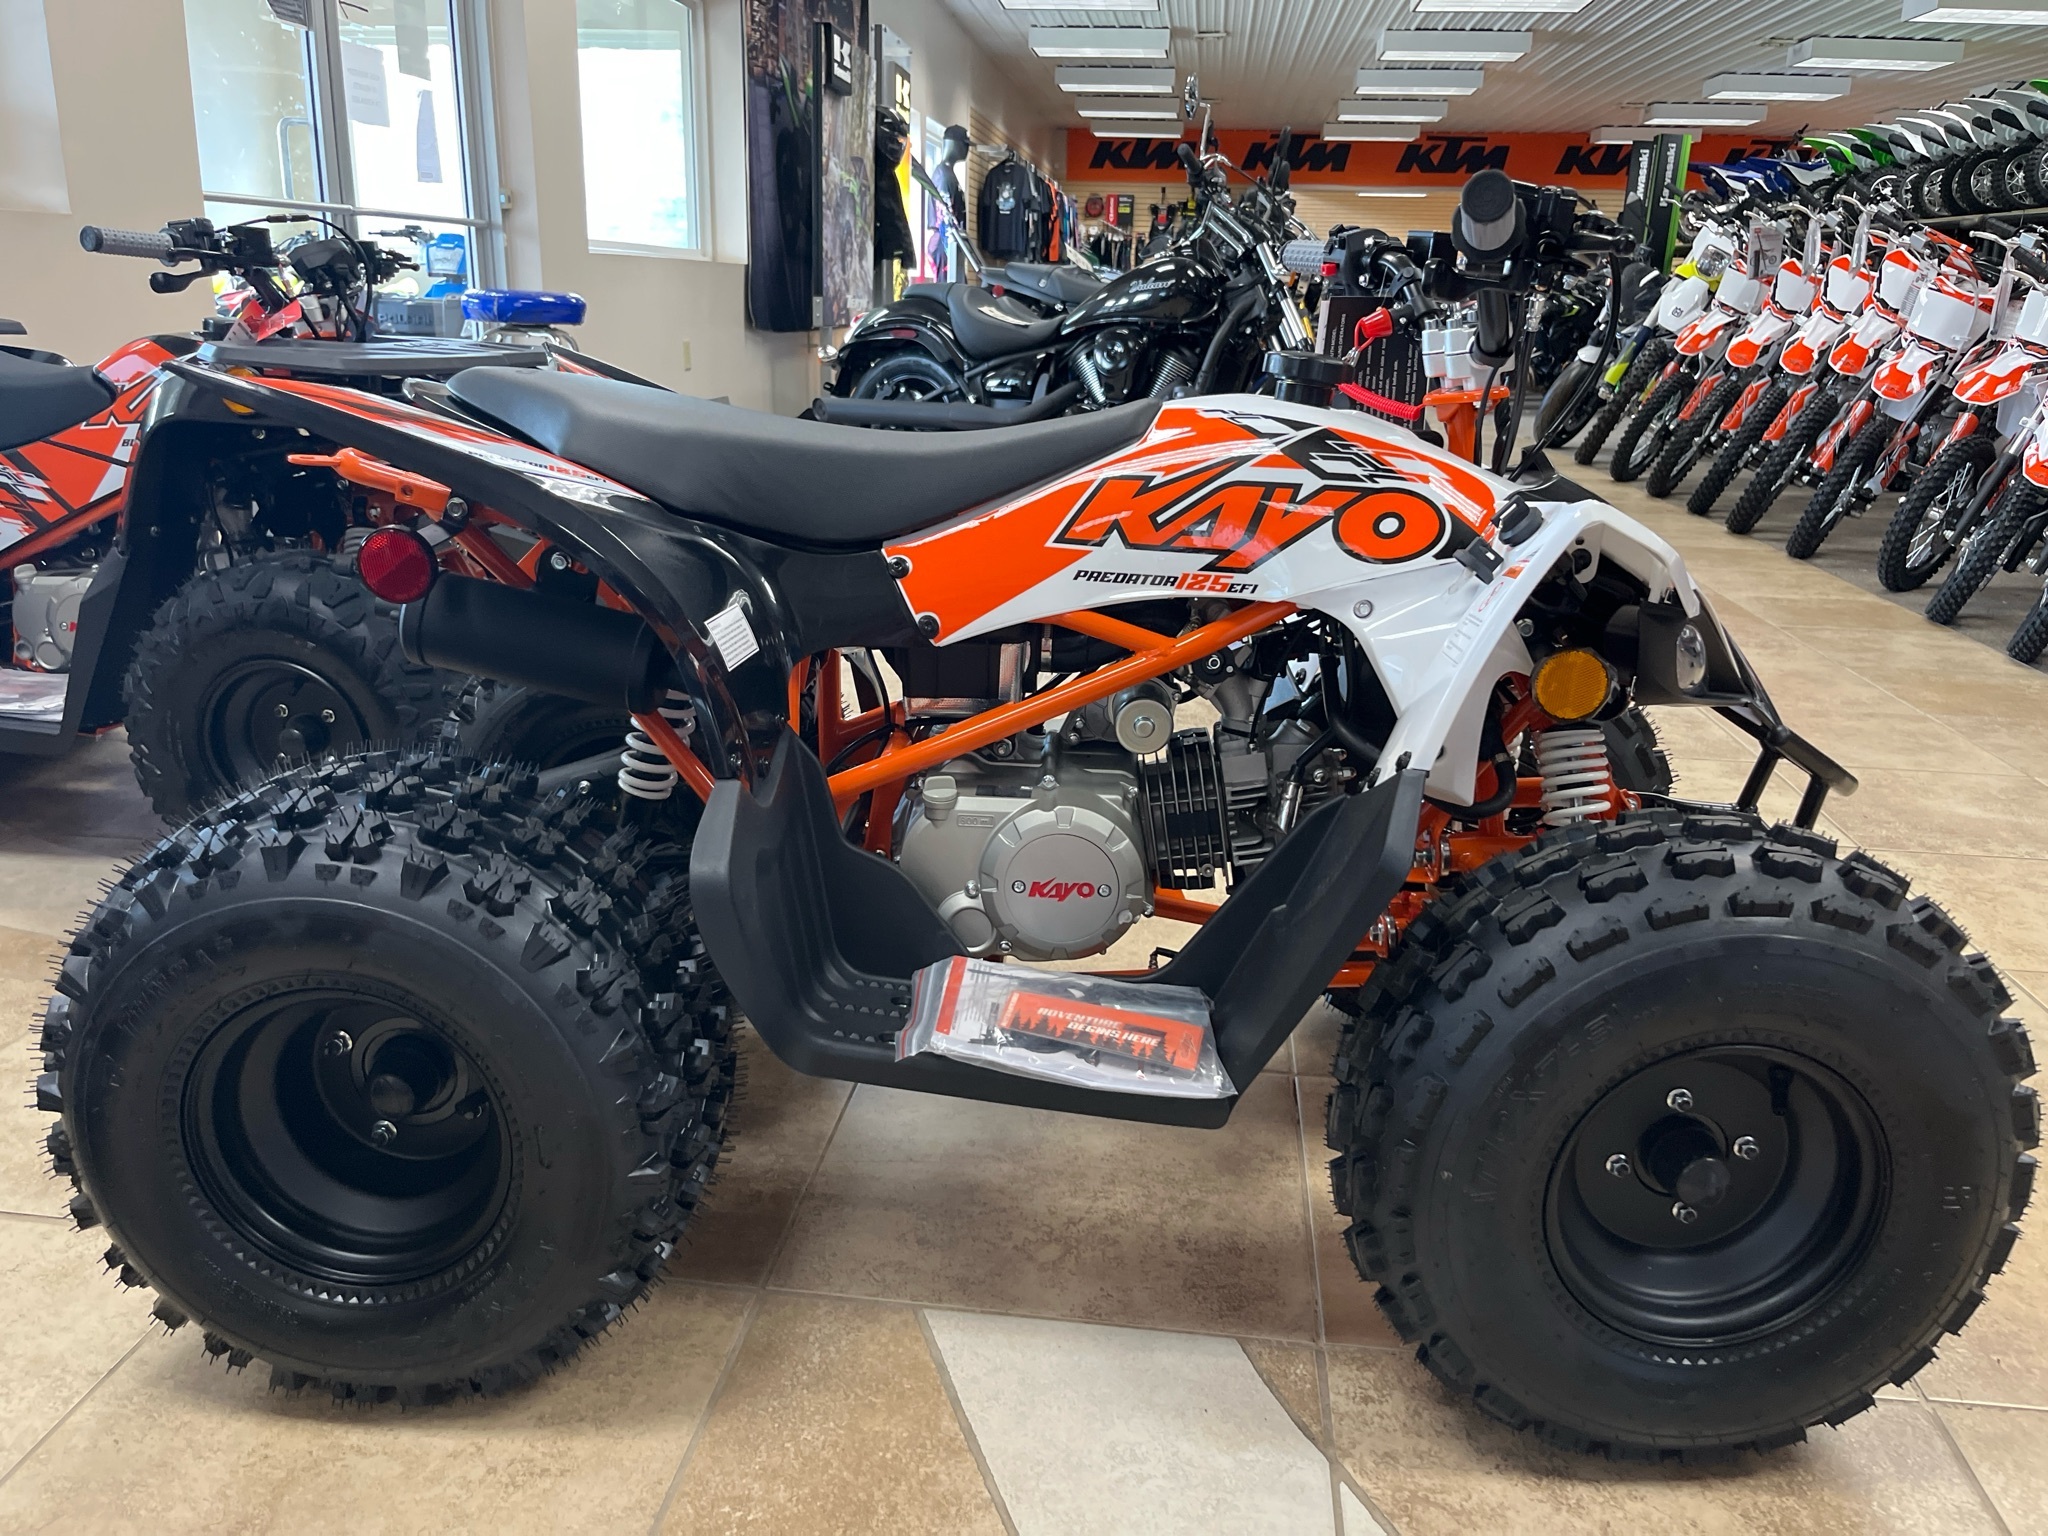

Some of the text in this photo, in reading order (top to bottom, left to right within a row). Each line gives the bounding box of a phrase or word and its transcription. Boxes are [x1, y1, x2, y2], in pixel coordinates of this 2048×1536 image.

[1241, 133, 1352, 172] KTM
[1395, 135, 1511, 174] KTM
[1056, 453, 1446, 573] KAYO
[1027, 877, 1096, 902] KAYO
[1036, 1007, 1125, 1029] ADVENTURE
[1066, 1021, 1162, 1047] BEGINS HERE
